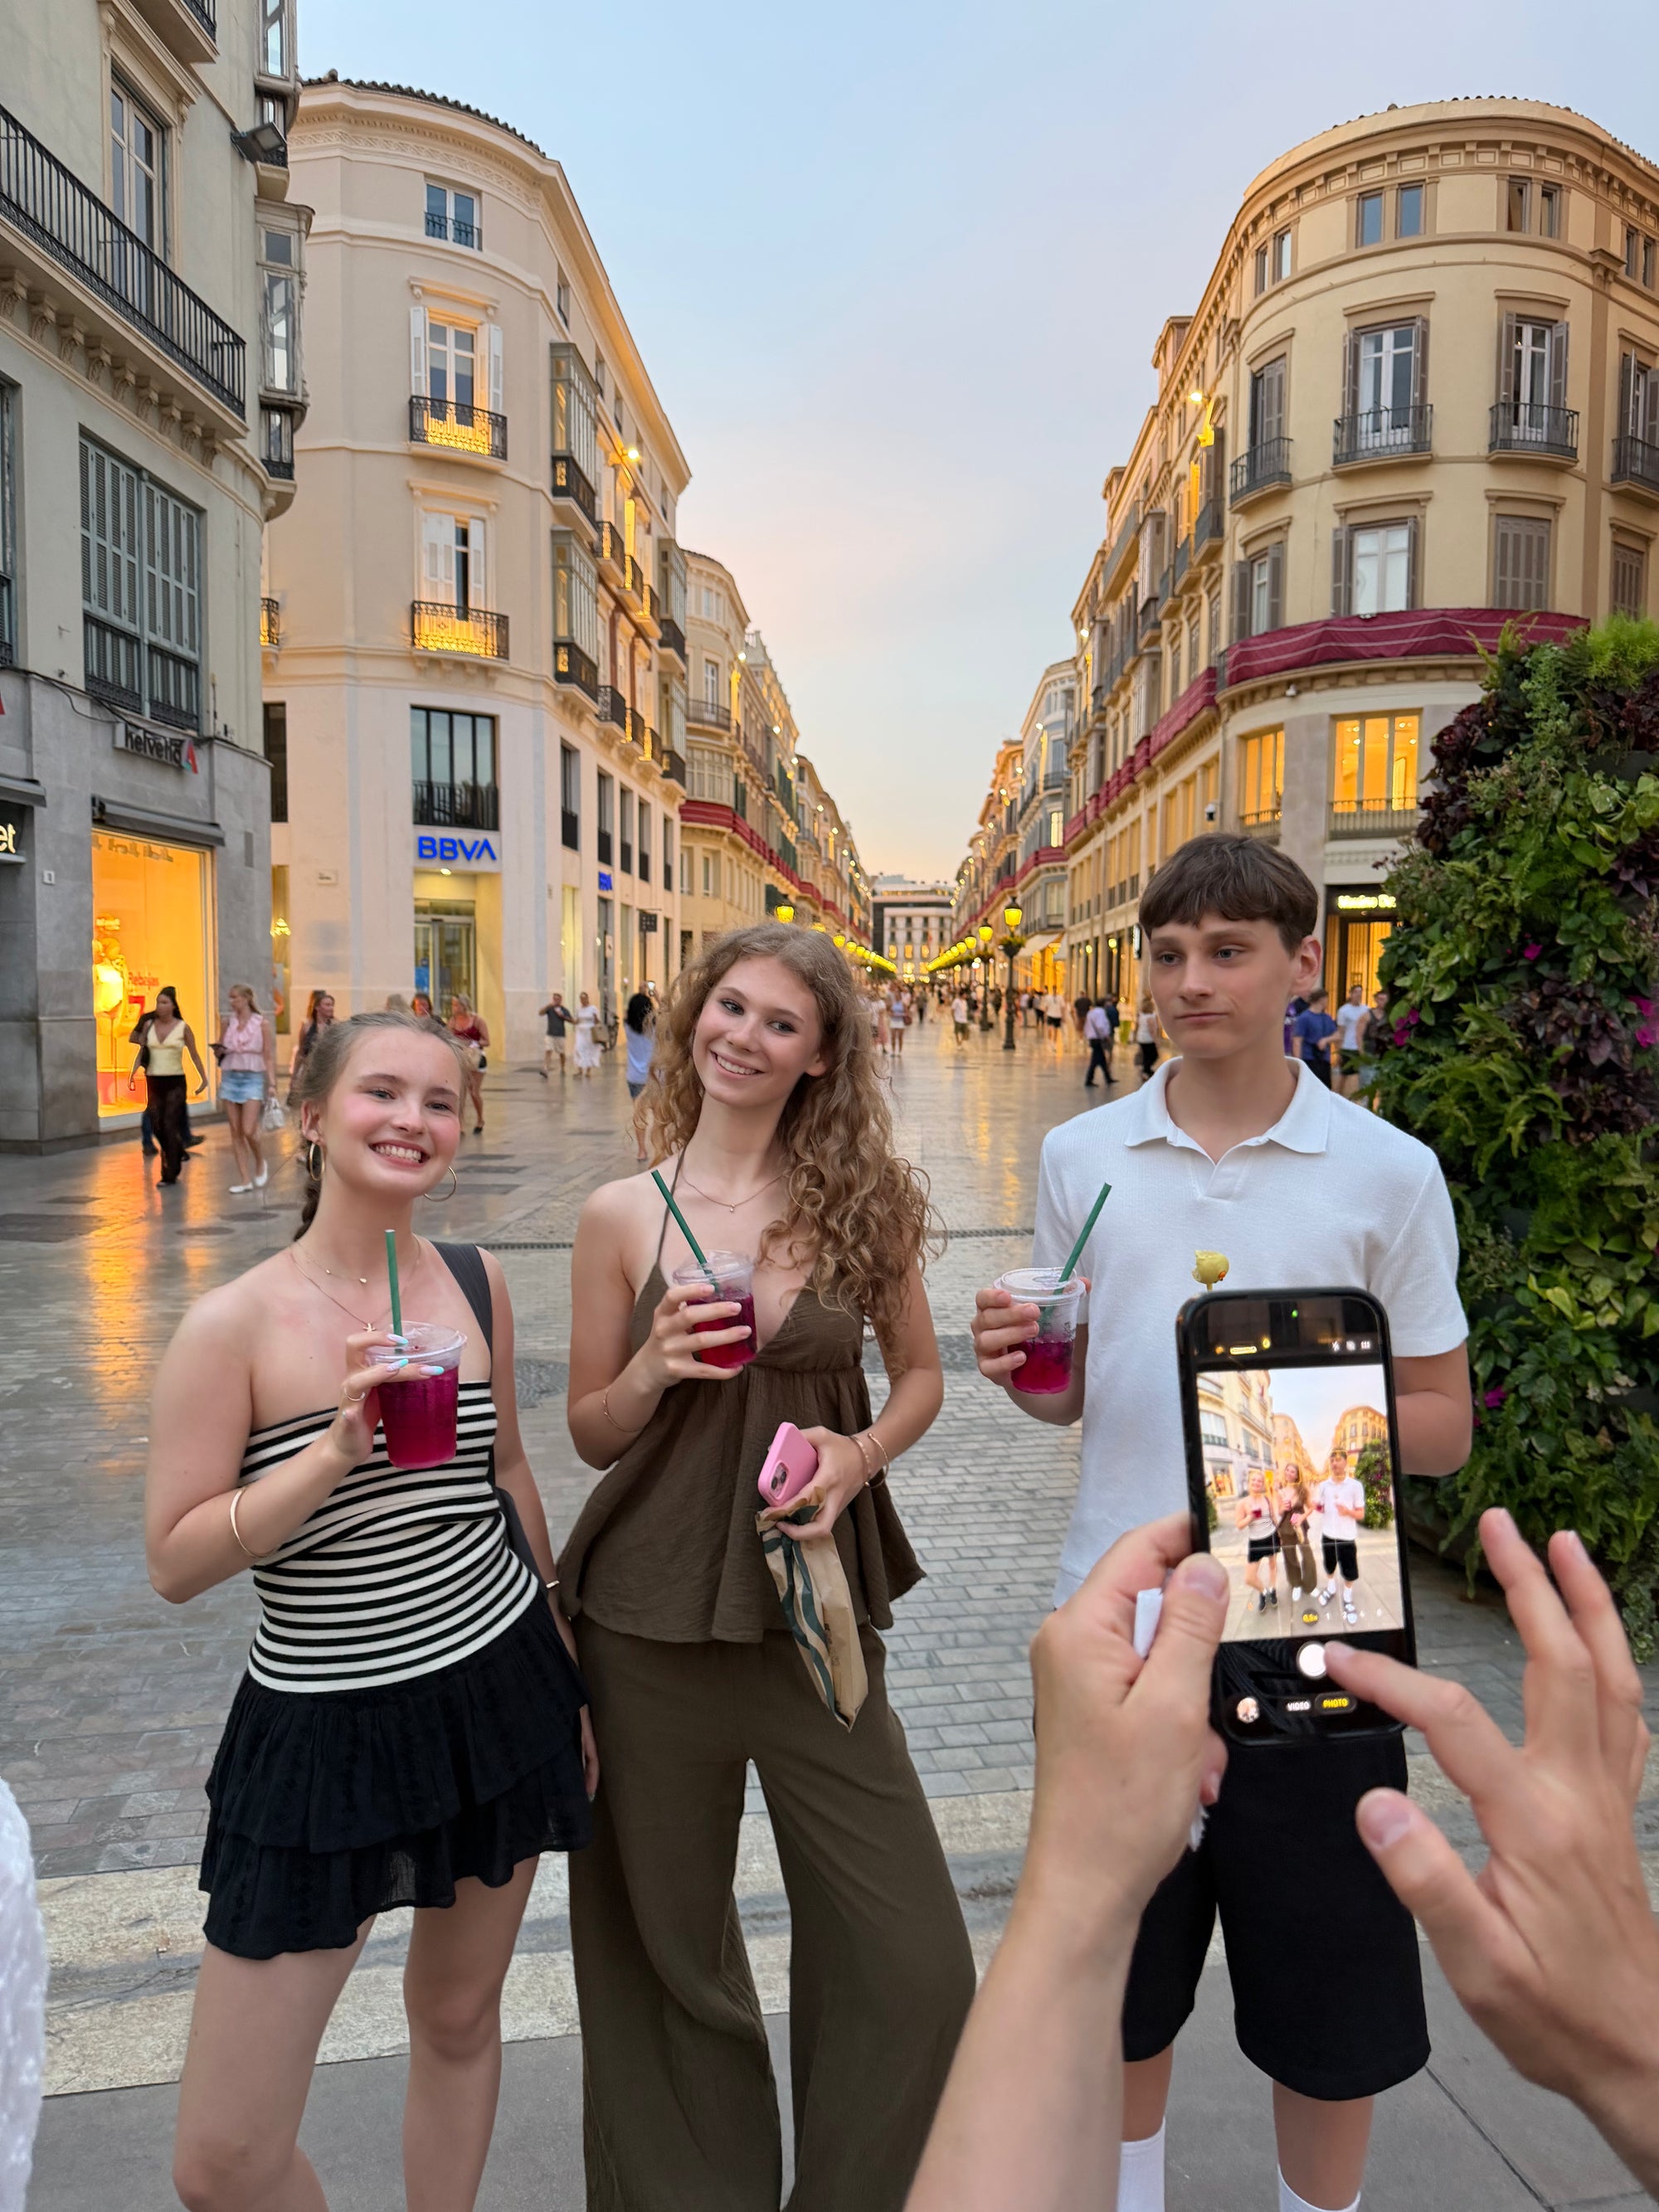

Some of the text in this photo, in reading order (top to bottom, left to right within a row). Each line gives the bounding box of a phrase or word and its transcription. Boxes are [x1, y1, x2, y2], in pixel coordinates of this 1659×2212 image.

[418, 836, 497, 861] BBVA
[1287, 1699, 1348, 1711] VIDEO PHOTO
